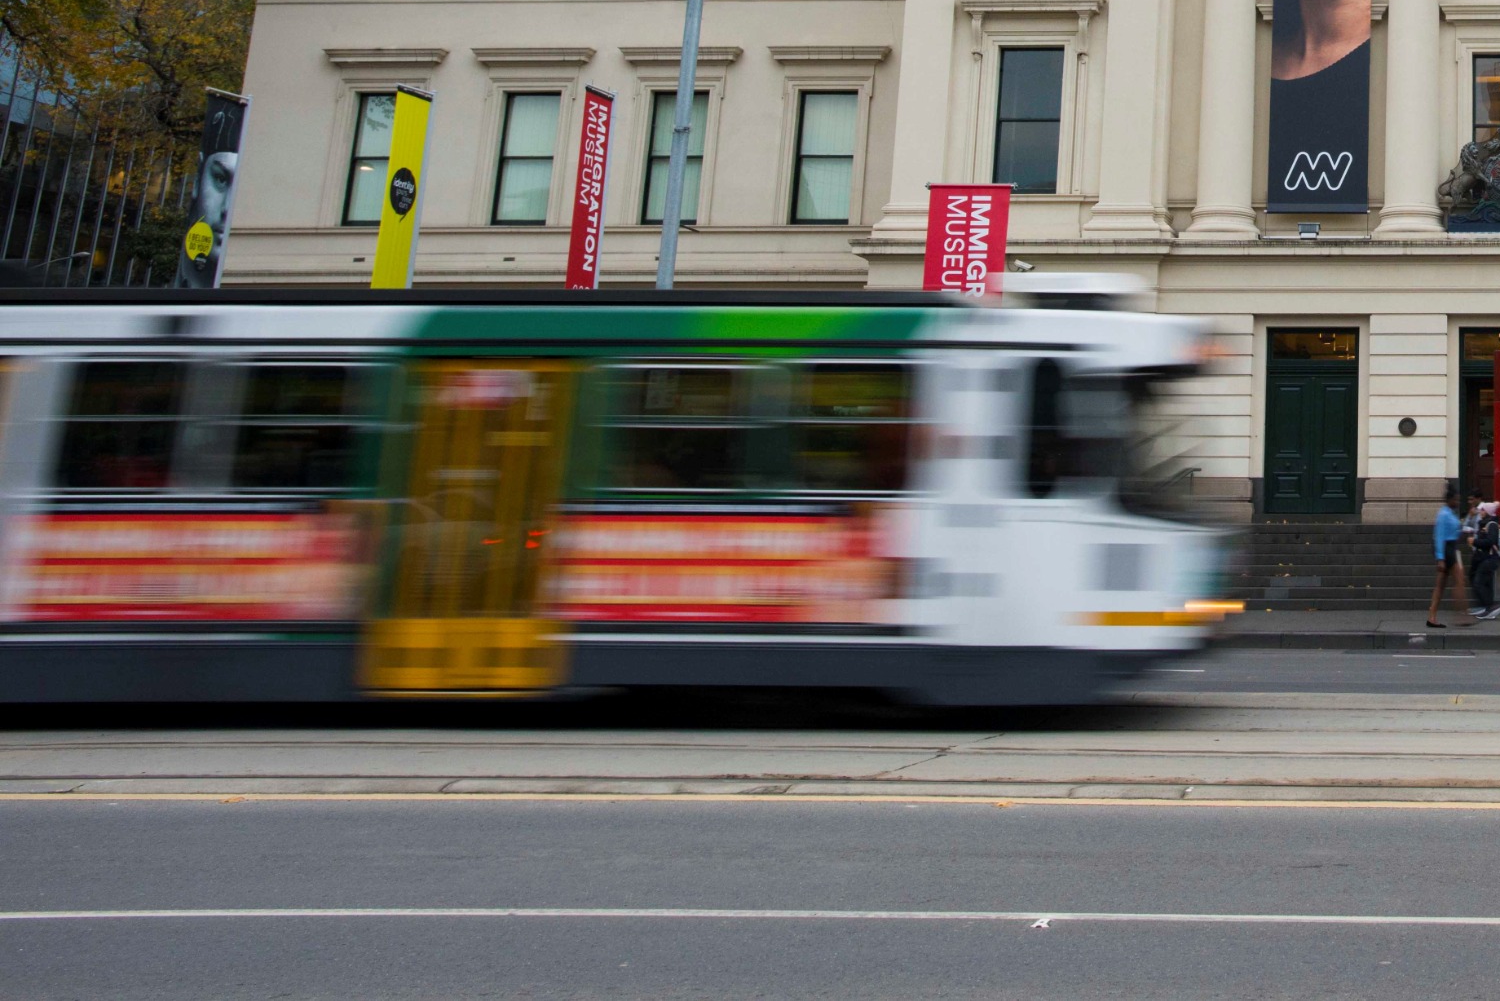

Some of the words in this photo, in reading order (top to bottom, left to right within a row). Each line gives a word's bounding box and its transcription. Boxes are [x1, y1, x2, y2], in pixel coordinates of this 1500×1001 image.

[393, 177, 415, 194] identity
[579, 100, 600, 205] MUSEUM
[582, 104, 608, 272] IMMIGRATION
